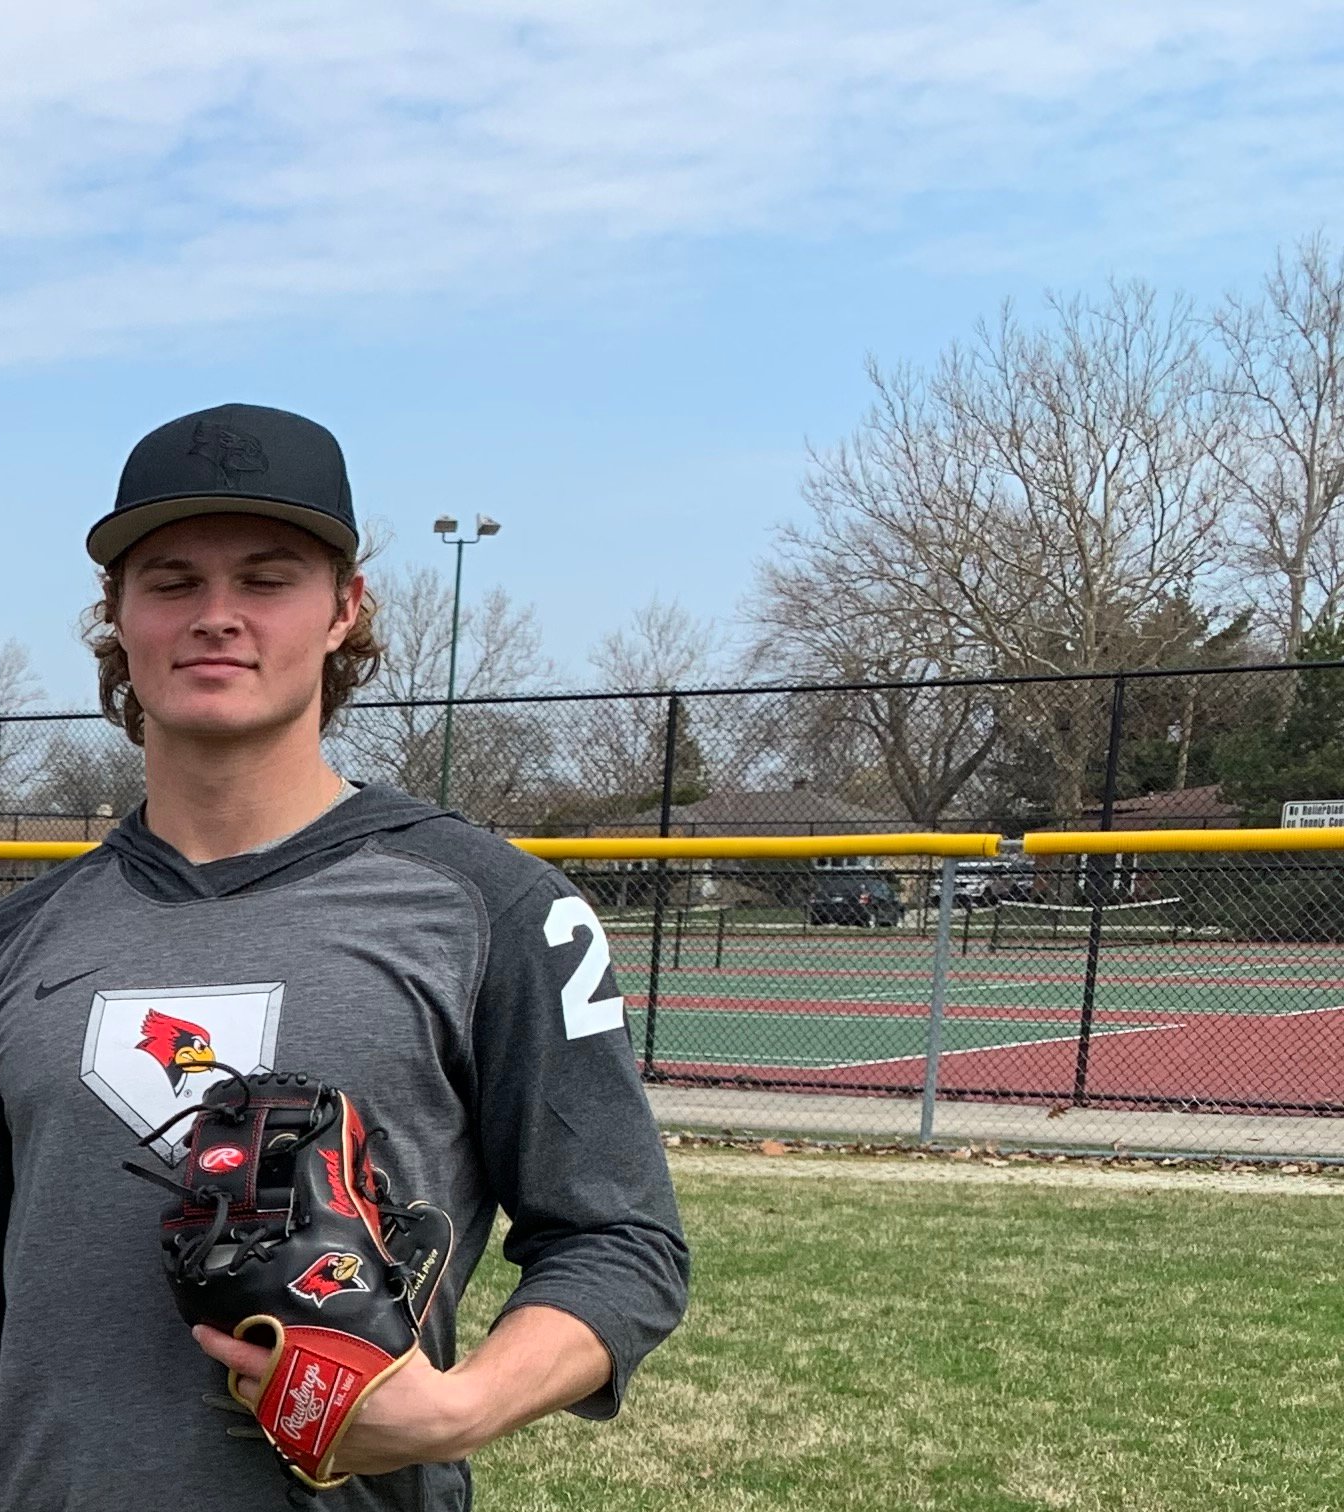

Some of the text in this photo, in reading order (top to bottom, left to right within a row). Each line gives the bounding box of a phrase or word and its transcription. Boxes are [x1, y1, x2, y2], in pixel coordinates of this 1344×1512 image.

[1289, 805, 1299, 815] No
[1300, 817, 1325, 828] Tennis
[543, 896, 625, 1041] 2
[280, 1363, 327, 1440] Rawlings
